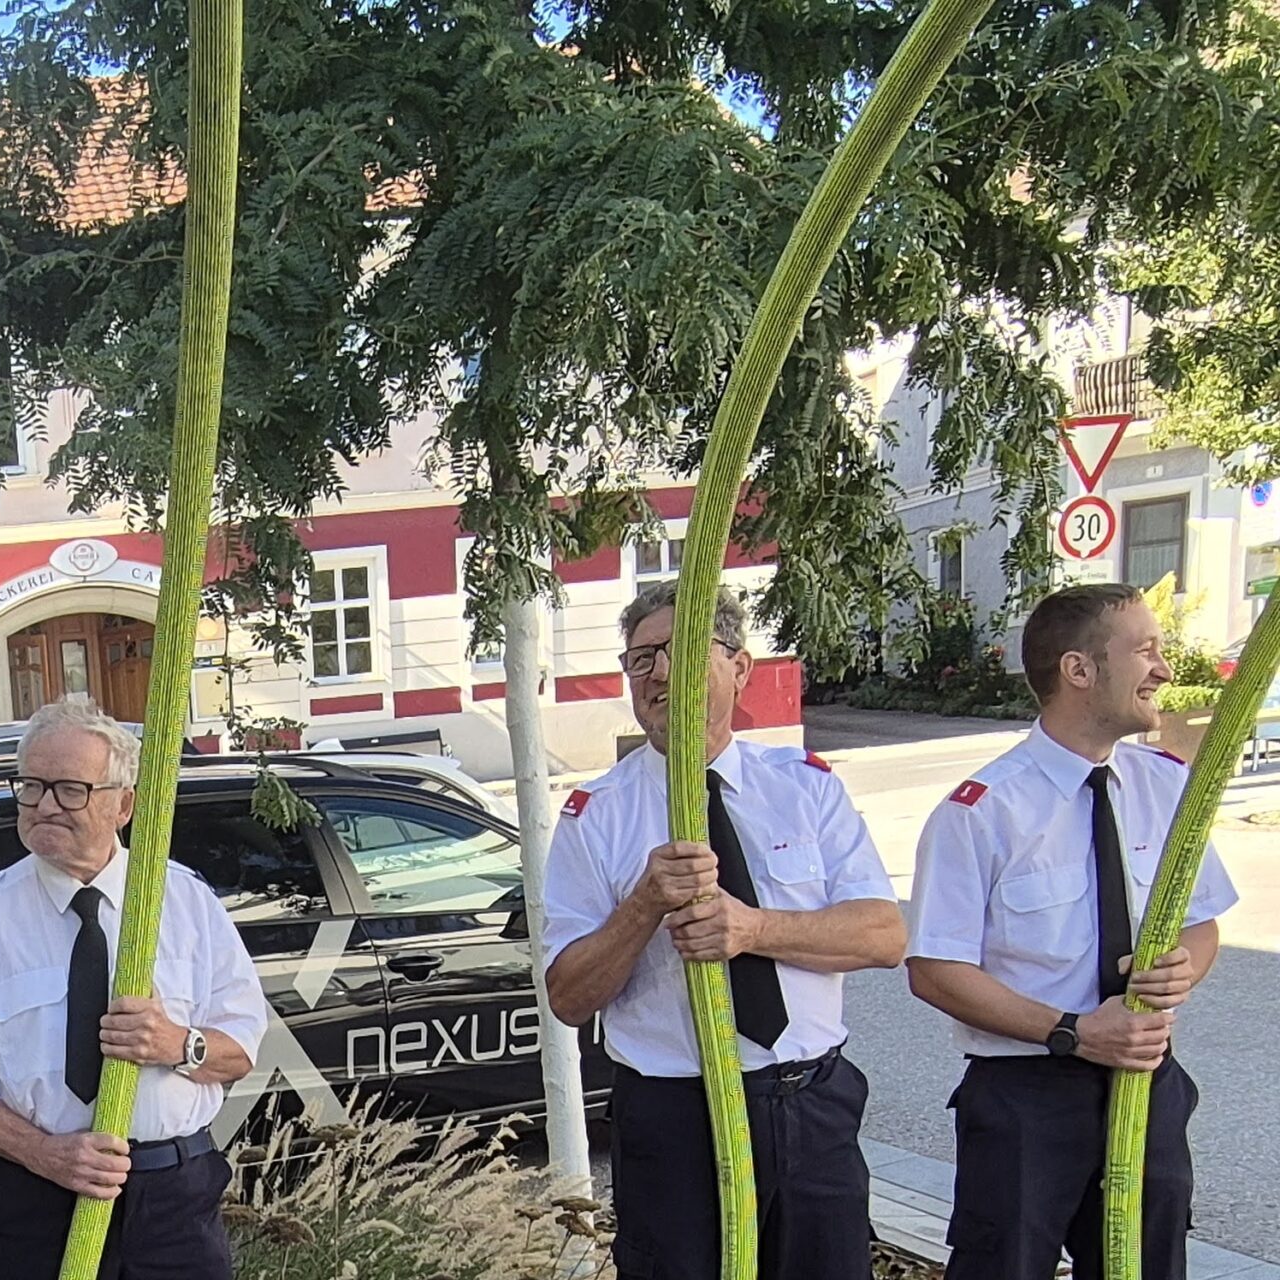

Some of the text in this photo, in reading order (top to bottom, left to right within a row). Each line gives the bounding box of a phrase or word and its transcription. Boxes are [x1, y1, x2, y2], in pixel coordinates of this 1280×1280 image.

[1072, 513, 1101, 542] 30
[131, 567, 154, 583] CA
[346, 1006, 542, 1080] nexus
